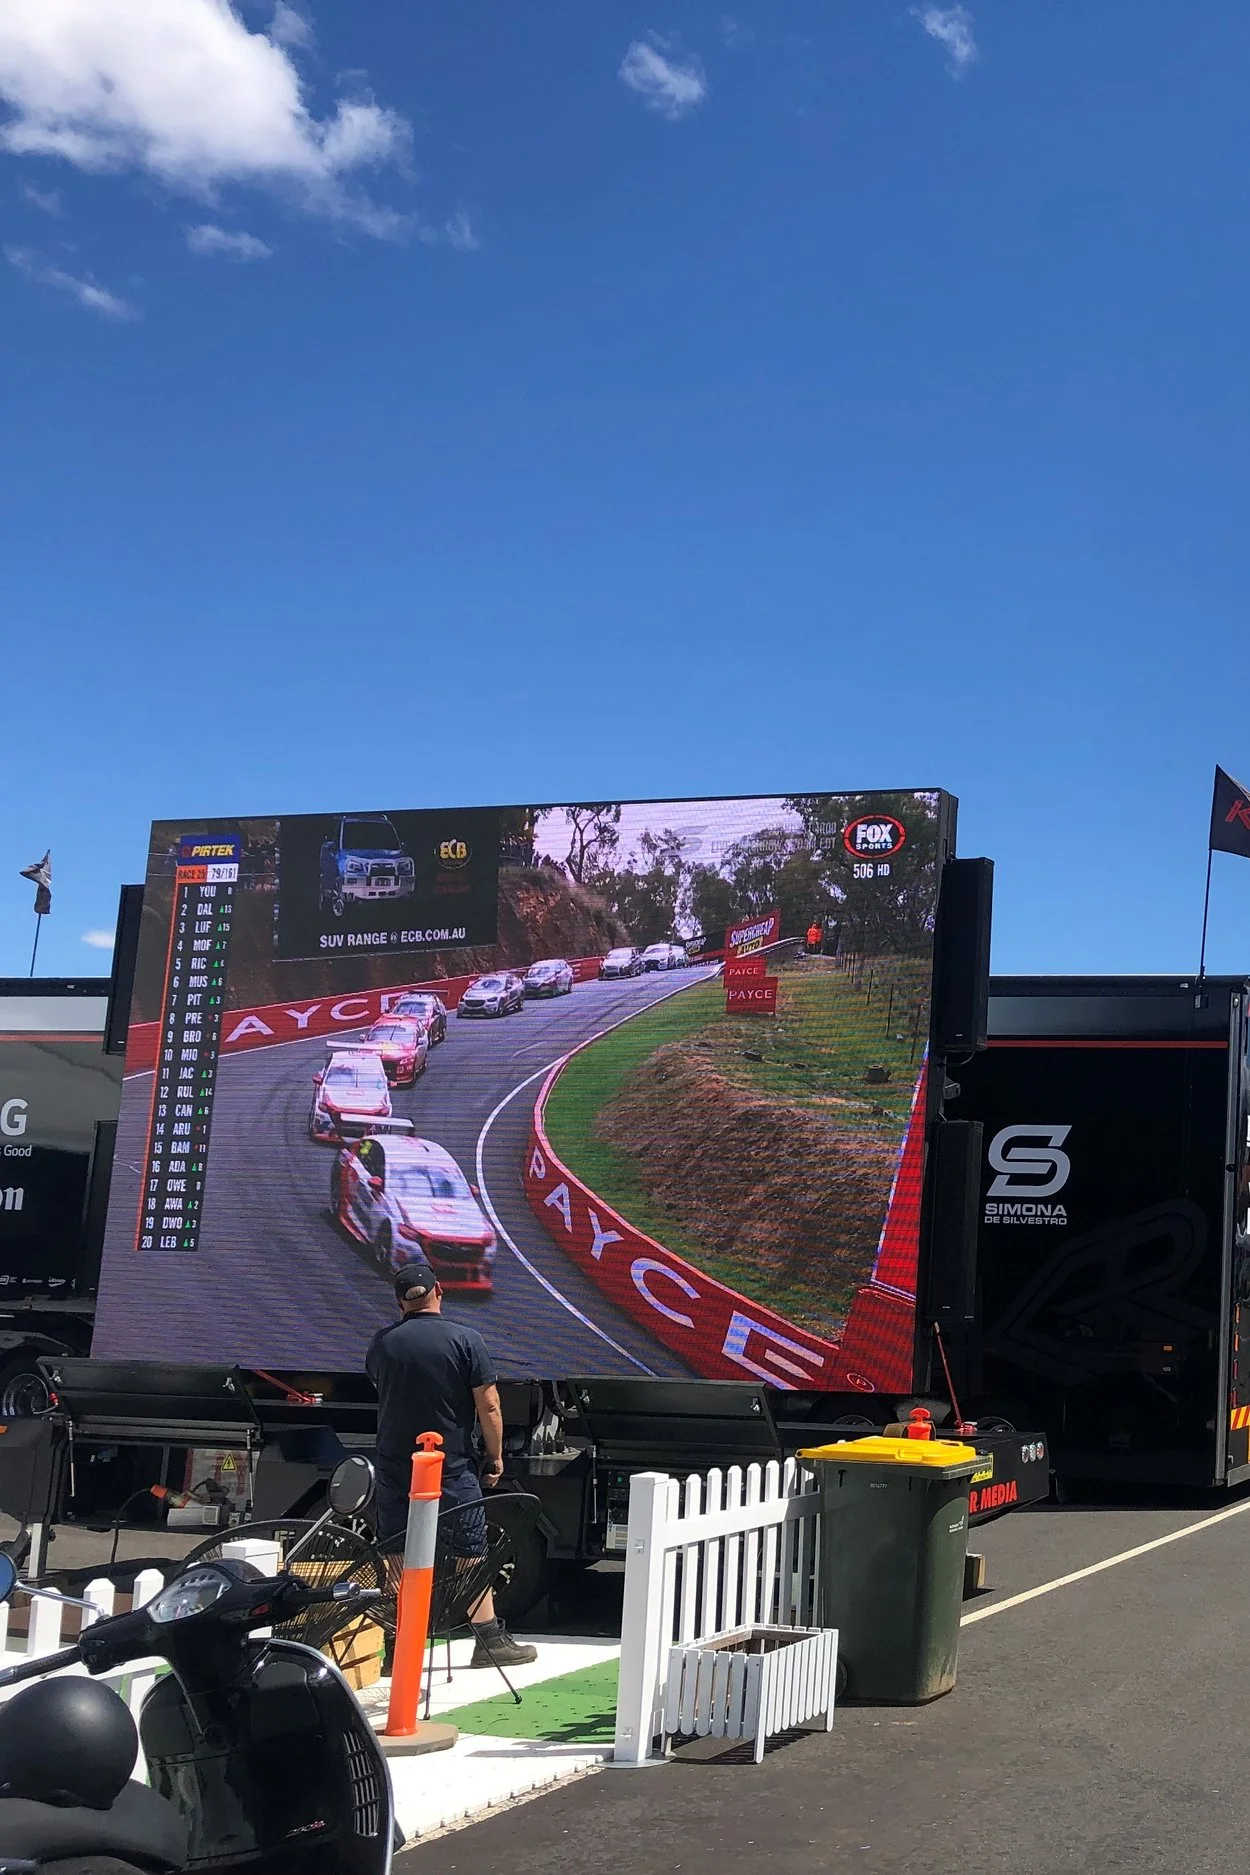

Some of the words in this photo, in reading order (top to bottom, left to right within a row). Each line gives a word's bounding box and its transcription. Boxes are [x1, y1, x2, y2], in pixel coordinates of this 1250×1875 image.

[856, 823, 893, 844] FOX
[191, 845, 235, 857] PIRTEK
[439, 838, 468, 859] ECB
[856, 842, 893, 850] SPORTS
[212, 867, 237, 880] 79/161
[853, 864, 874, 879] 506
[877, 863, 890, 876] HD
[184, 887, 188, 898] 1
[200, 886, 216, 898] YOU
[180, 904, 188, 916] 2
[197, 903, 213, 916] DAL
[224, 904, 232, 914] 13
[179, 922, 186, 934] 3
[194, 921, 212, 933] LUF
[222, 923, 230, 932] 15
[730, 917, 775, 948] SUPERCHEAP
[320, 934, 344, 948] SUV
[347, 932, 387, 946] RANGE
[400, 927, 466, 943] ECB.COM.AU
[177, 940, 183, 952] 4
[193, 940, 212, 951] MOF
[175, 958, 181, 970] 5
[191, 958, 206, 970] RIC
[729, 967, 760, 976] PAYCE
[173, 976, 180, 988] 6
[188, 976, 208, 988] MUS
[172, 994, 178, 1006] 7
[186, 994, 202, 1006] PIT
[216, 996, 220, 1004] 3
[729, 989, 773, 1000] PAYCE
[169, 1012, 176, 1025] 8
[185, 1012, 203, 1024] PRE
[214, 1014, 219, 1022] 3
[167, 1030, 174, 1043] 9
[183, 1030, 202, 1043] BRO
[164, 1049, 173, 1061] 10
[210, 1051, 215, 1060] 3
[162, 1068, 170, 1080] 11
[178, 1066, 194, 1080] JAC
[208, 1070, 213, 1078] 3
[160, 1086, 169, 1098] 12
[177, 1086, 194, 1098] RUL
[158, 1104, 167, 1116] 13
[175, 1104, 192, 1116] CAN
[156, 1122, 164, 1135] 14
[172, 1122, 190, 1135] ARU
[4, 1144, 32, 1157] Good
[154, 1142, 163, 1154] 15
[171, 1141, 190, 1154] BAM
[152, 1160, 160, 1172] 16
[168, 1160, 186, 1172] ADA
[150, 1179, 158, 1192] 17
[166, 1179, 187, 1192] OWE
[148, 1198, 156, 1210] 18
[164, 1198, 182, 1210] AWA
[194, 1200, 199, 1210] 2
[985, 1203, 1067, 1216] SIMONA
[146, 1216, 154, 1229] 19
[162, 1216, 182, 1229] DWO
[192, 1220, 196, 1228] 3
[984, 1216, 1000, 1224] DE
[1002, 1216, 1067, 1225] SILVESTRO
[142, 1236, 152, 1248] 20
[160, 1236, 177, 1248] LEB
[190, 1238, 194, 1247] 5
[980, 1480, 1018, 1511] MEDIA
